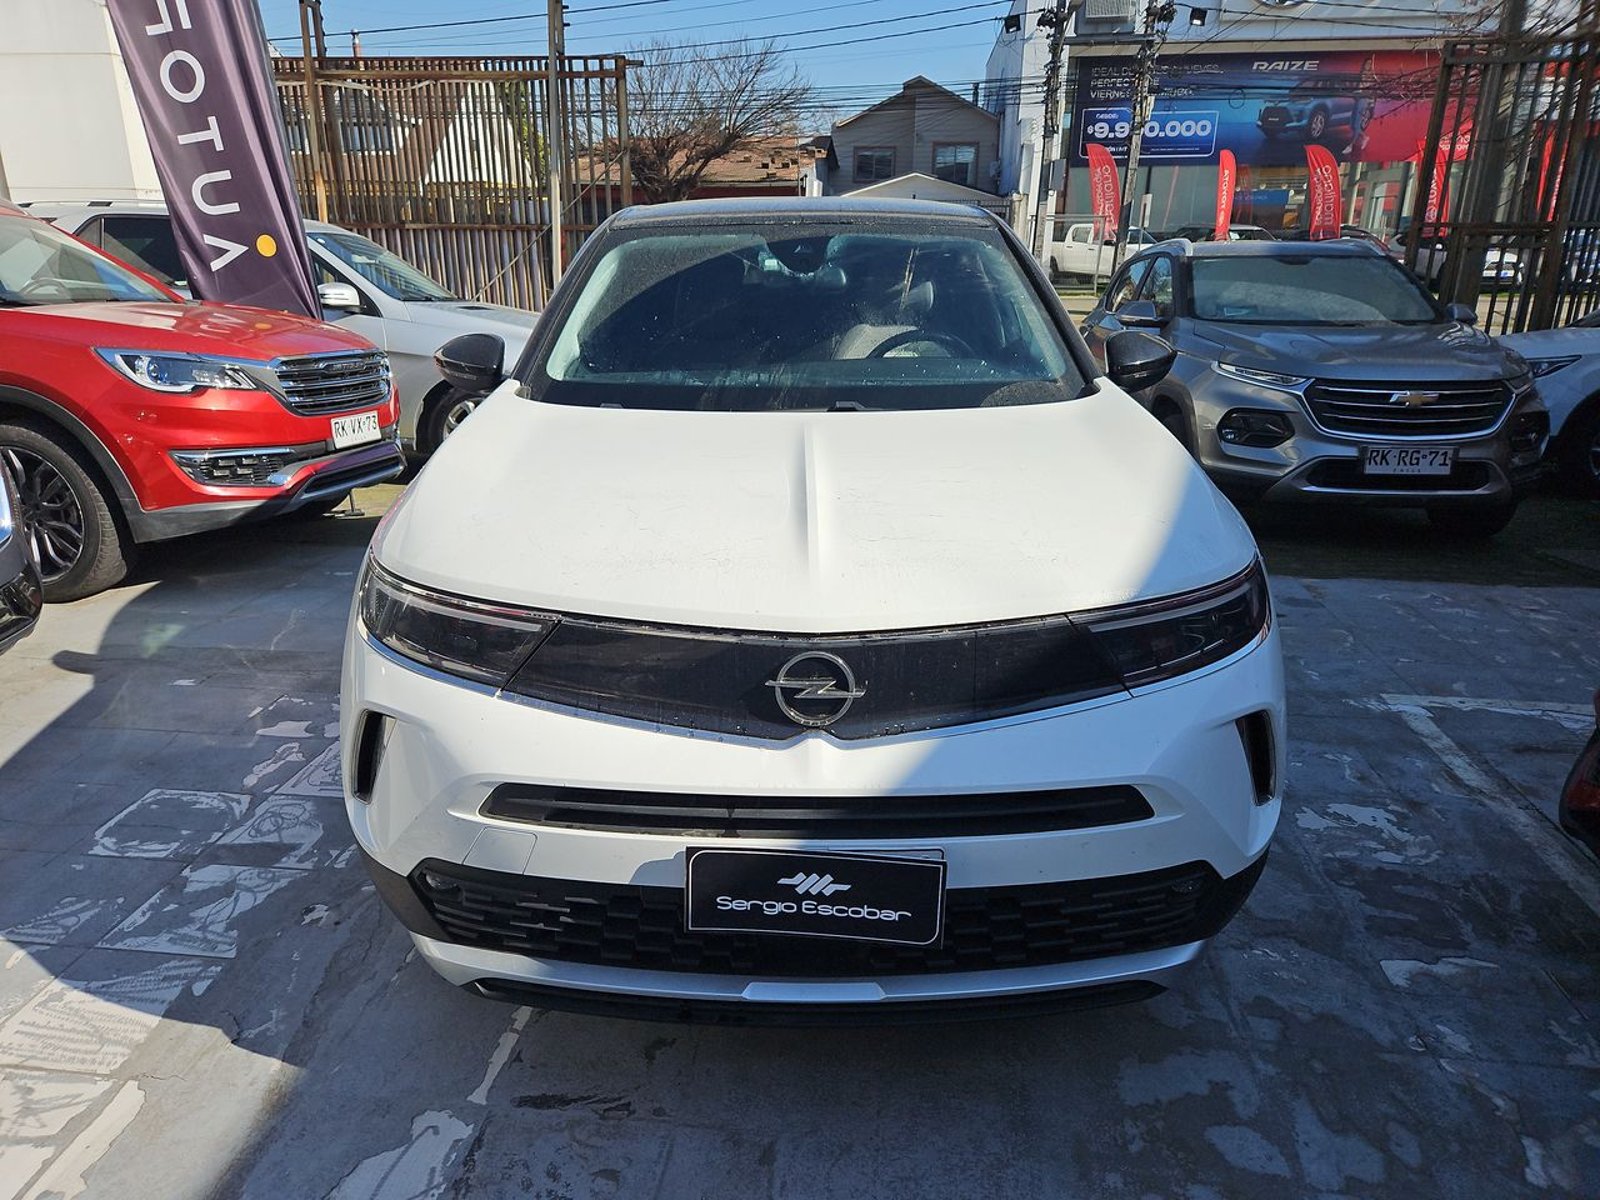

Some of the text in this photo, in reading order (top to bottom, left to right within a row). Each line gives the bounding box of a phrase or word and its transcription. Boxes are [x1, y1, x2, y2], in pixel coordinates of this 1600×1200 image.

[1252, 60, 1320, 71] RAIZE
[1087, 120, 1211, 138] $9.90.000
[715, 896, 912, 922] Sergio Escobar
